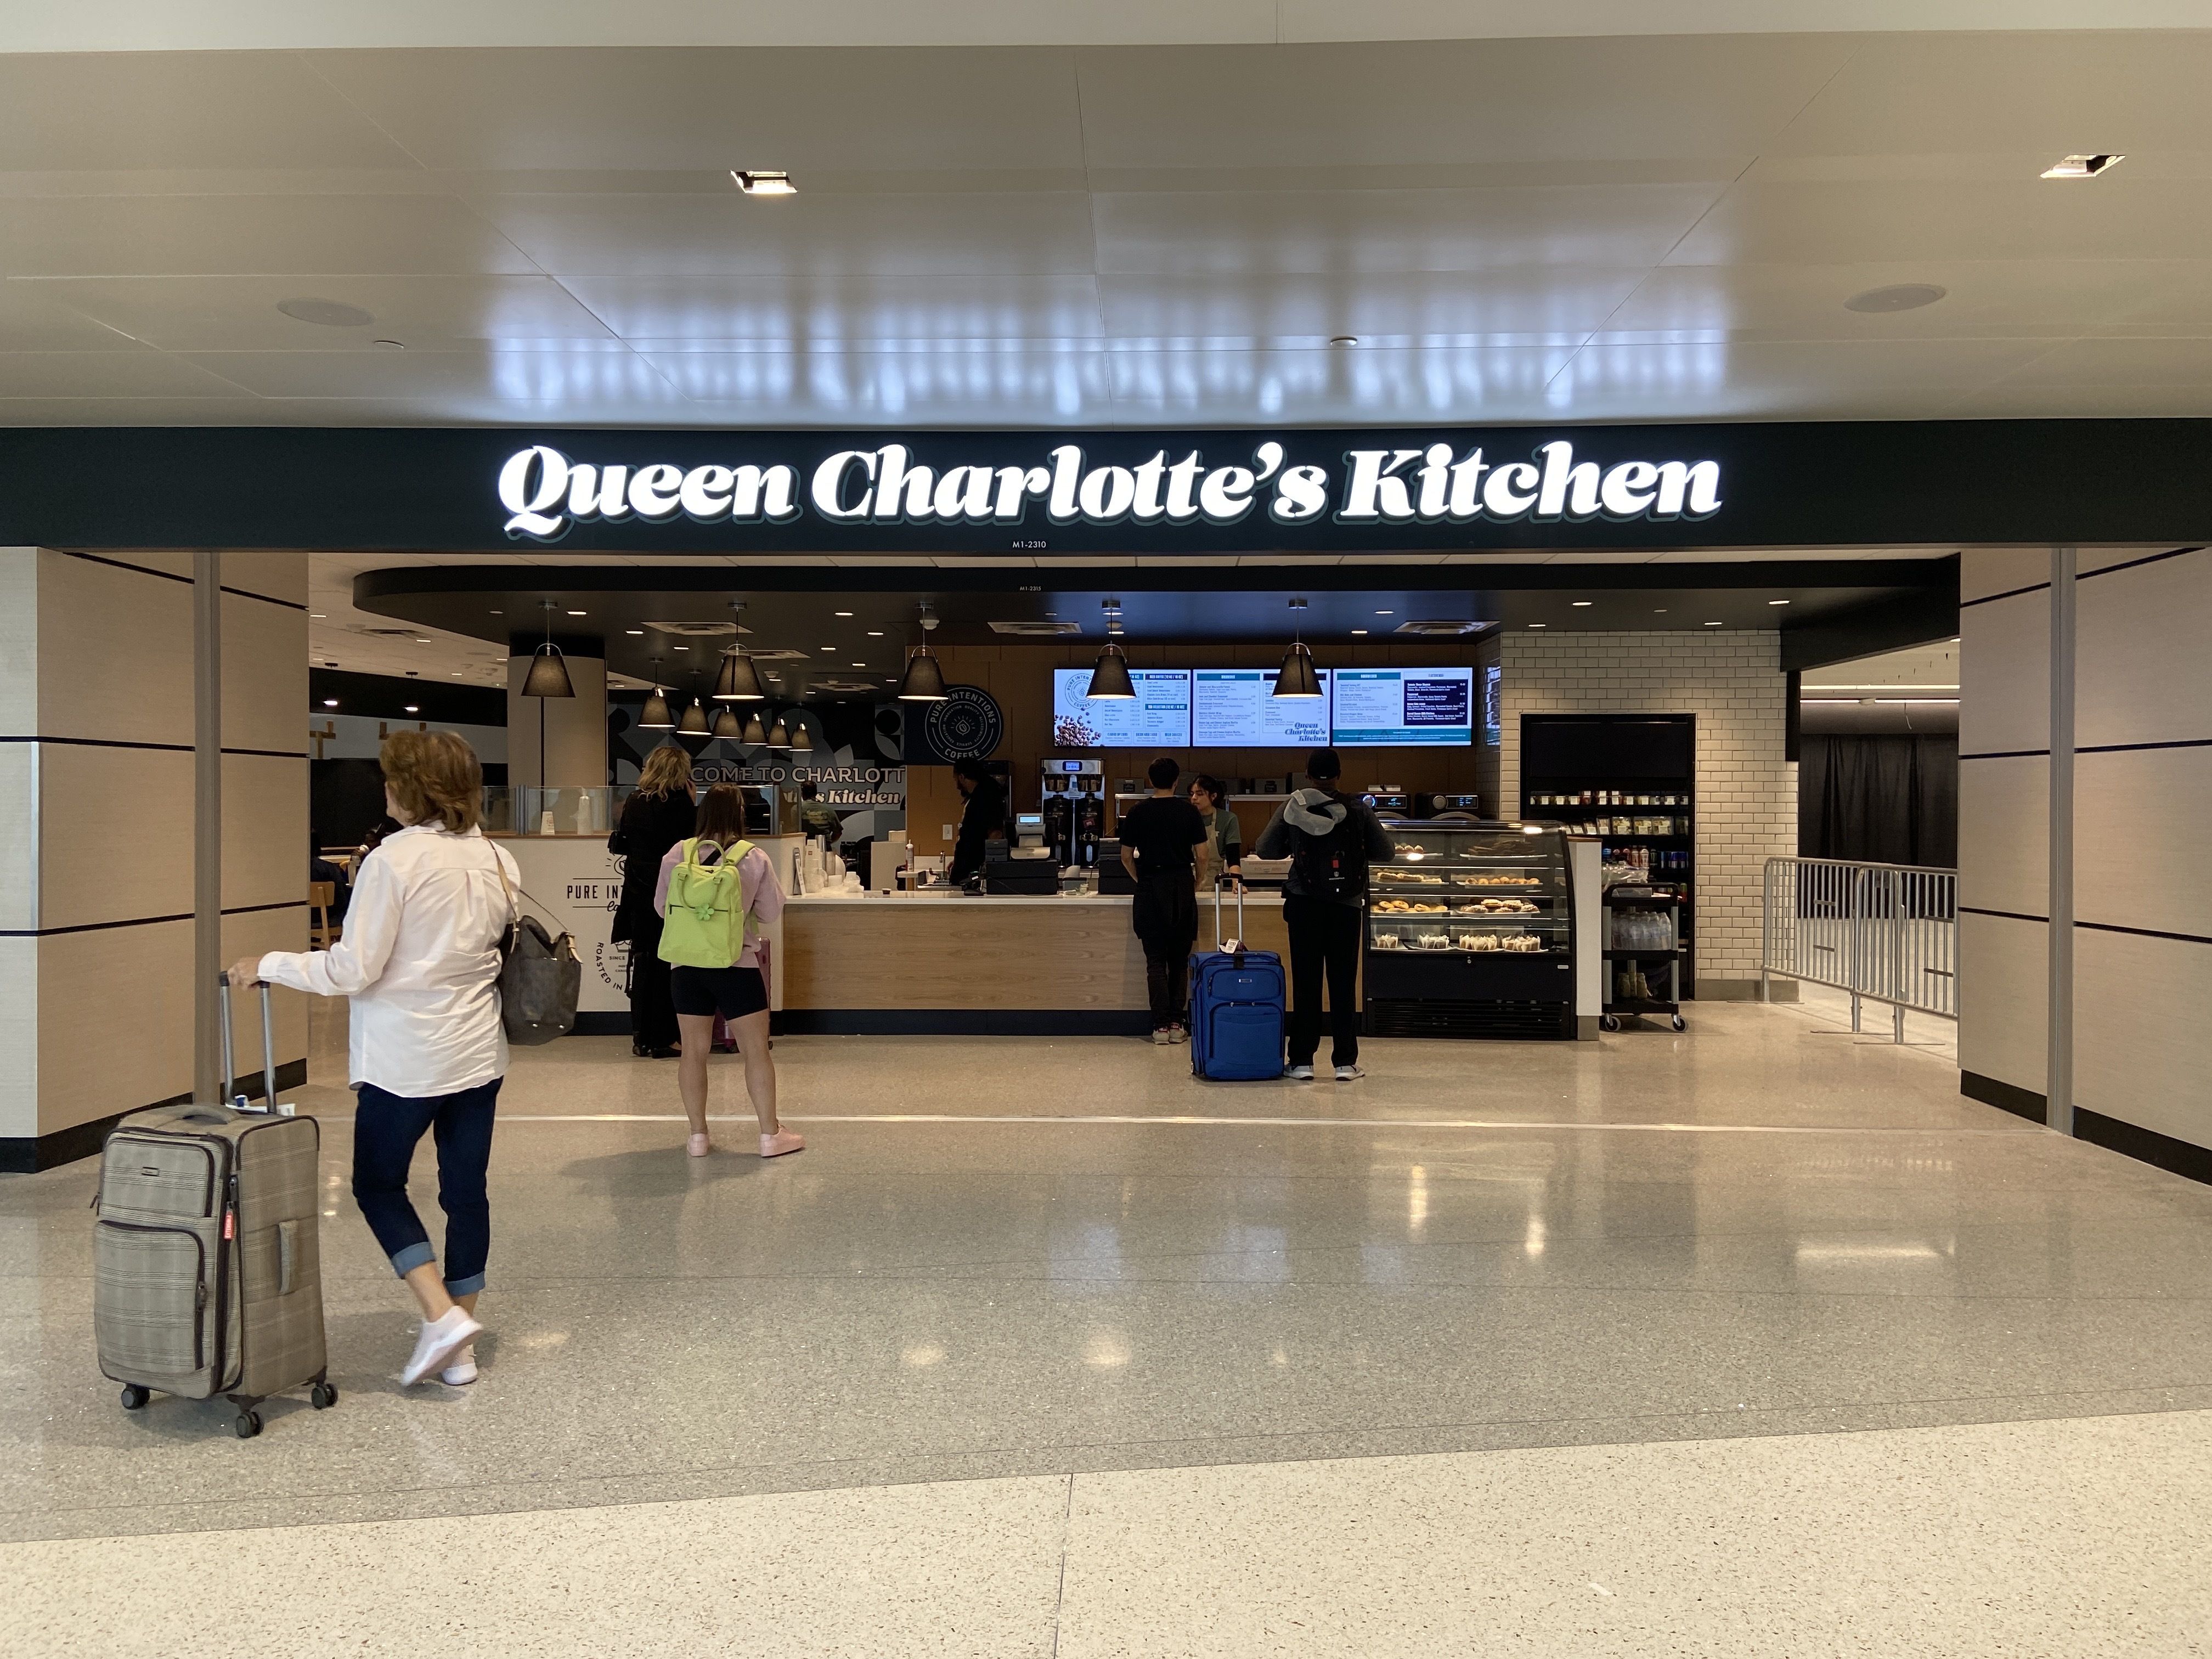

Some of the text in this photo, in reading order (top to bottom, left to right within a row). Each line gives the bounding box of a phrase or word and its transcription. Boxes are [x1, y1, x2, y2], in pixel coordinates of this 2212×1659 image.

[498, 441, 1722, 534] Queen Charlotte's Kitchen
[930, 691, 996, 724] PURE INTENTIONS
[945, 748, 980, 759] COFFEE
[690, 767, 906, 783] COME TO CHARLOTT
[827, 789, 900, 804] Kitchen
[567, 885, 598, 899] PURE
[596, 942, 623, 991] ROASTED IN
